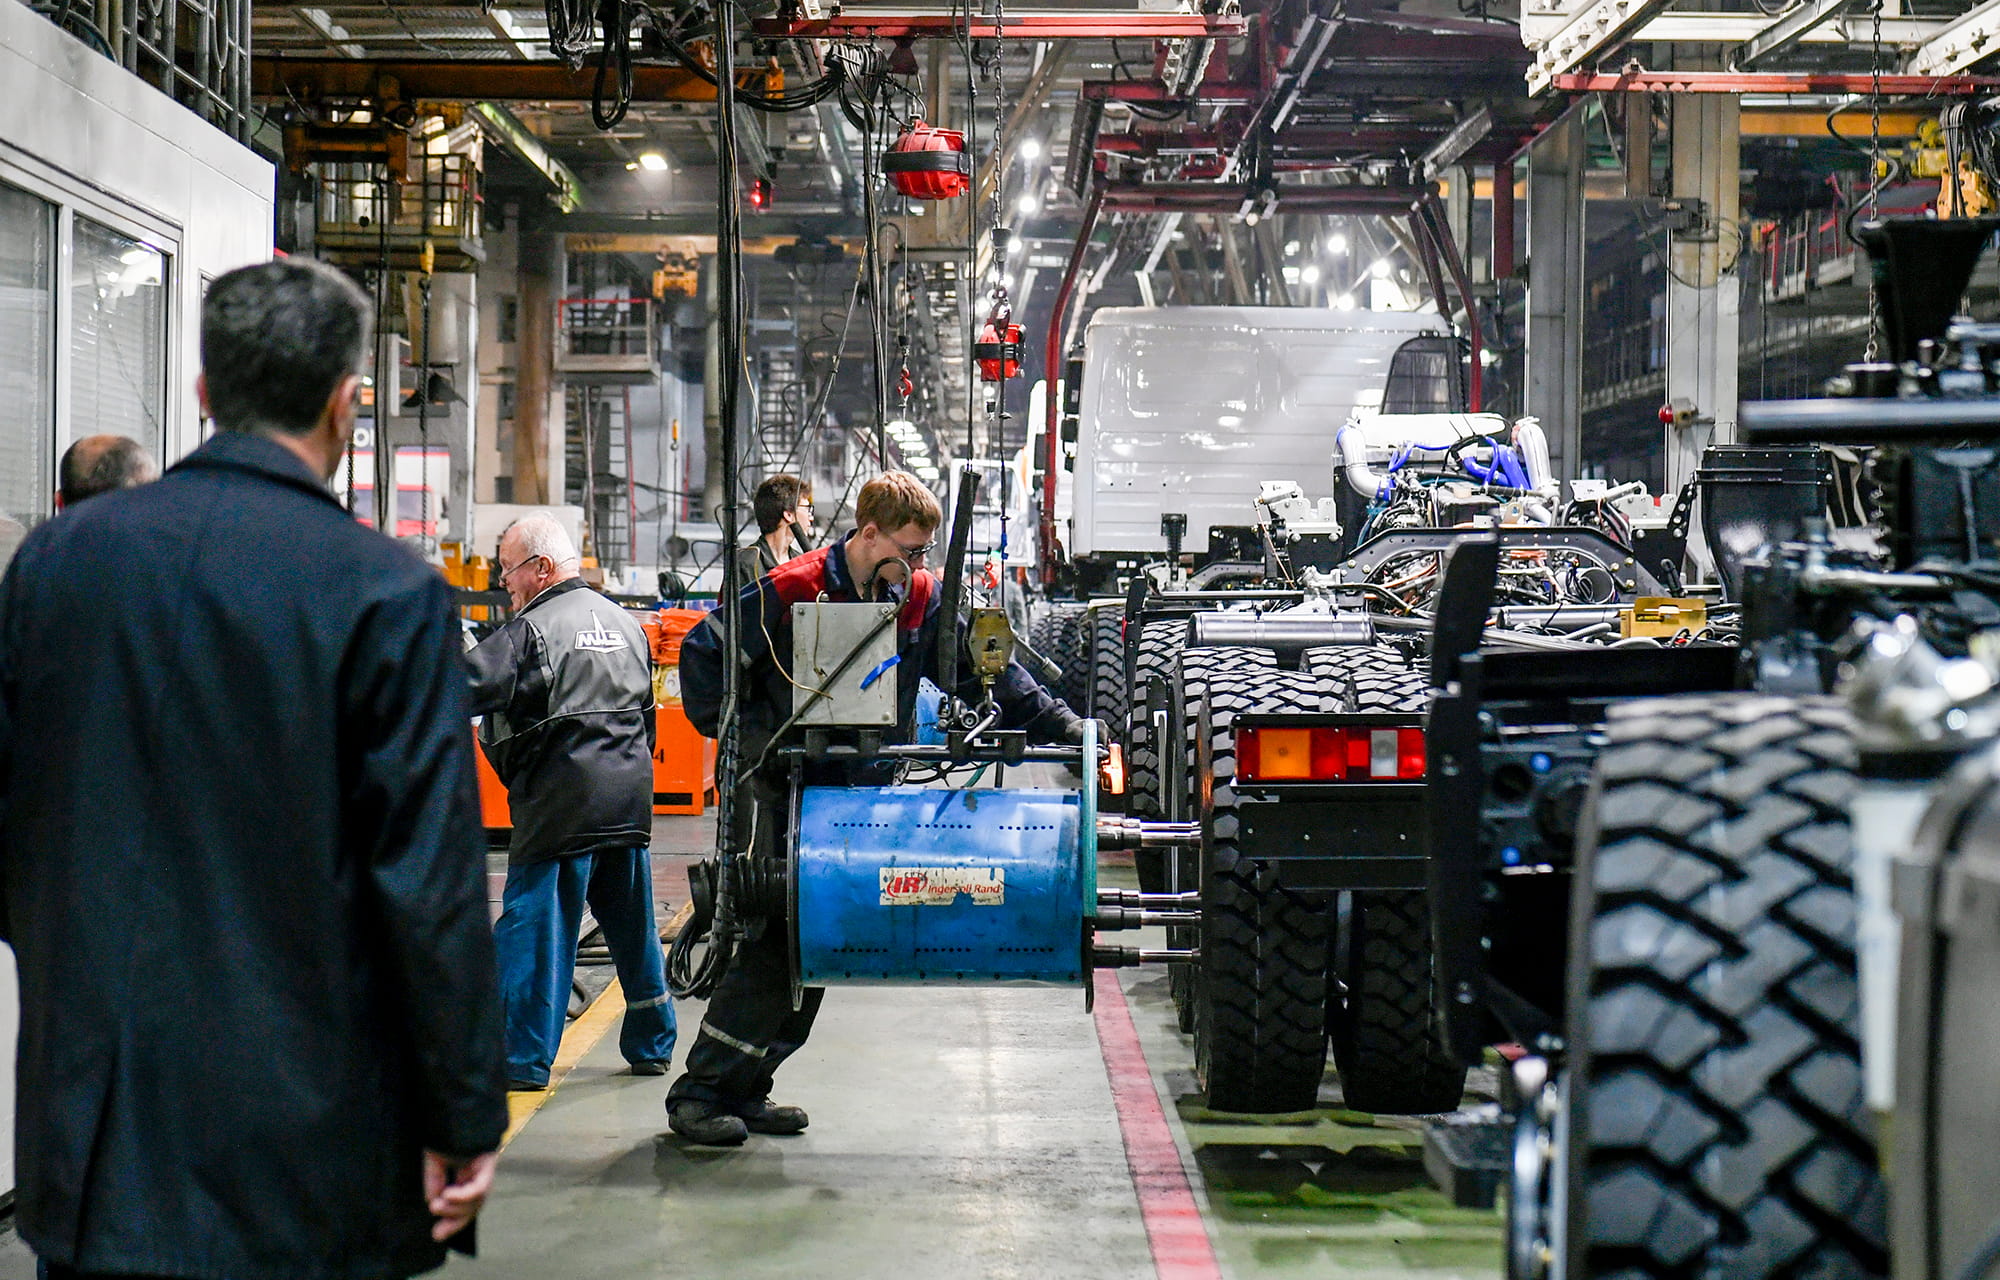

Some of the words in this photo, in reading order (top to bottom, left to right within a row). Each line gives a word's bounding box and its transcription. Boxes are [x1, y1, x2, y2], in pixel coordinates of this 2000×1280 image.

[894, 876, 921, 894] IR
[927, 884, 972, 895] Ingersoll
[974, 884, 1001, 894] Rand
